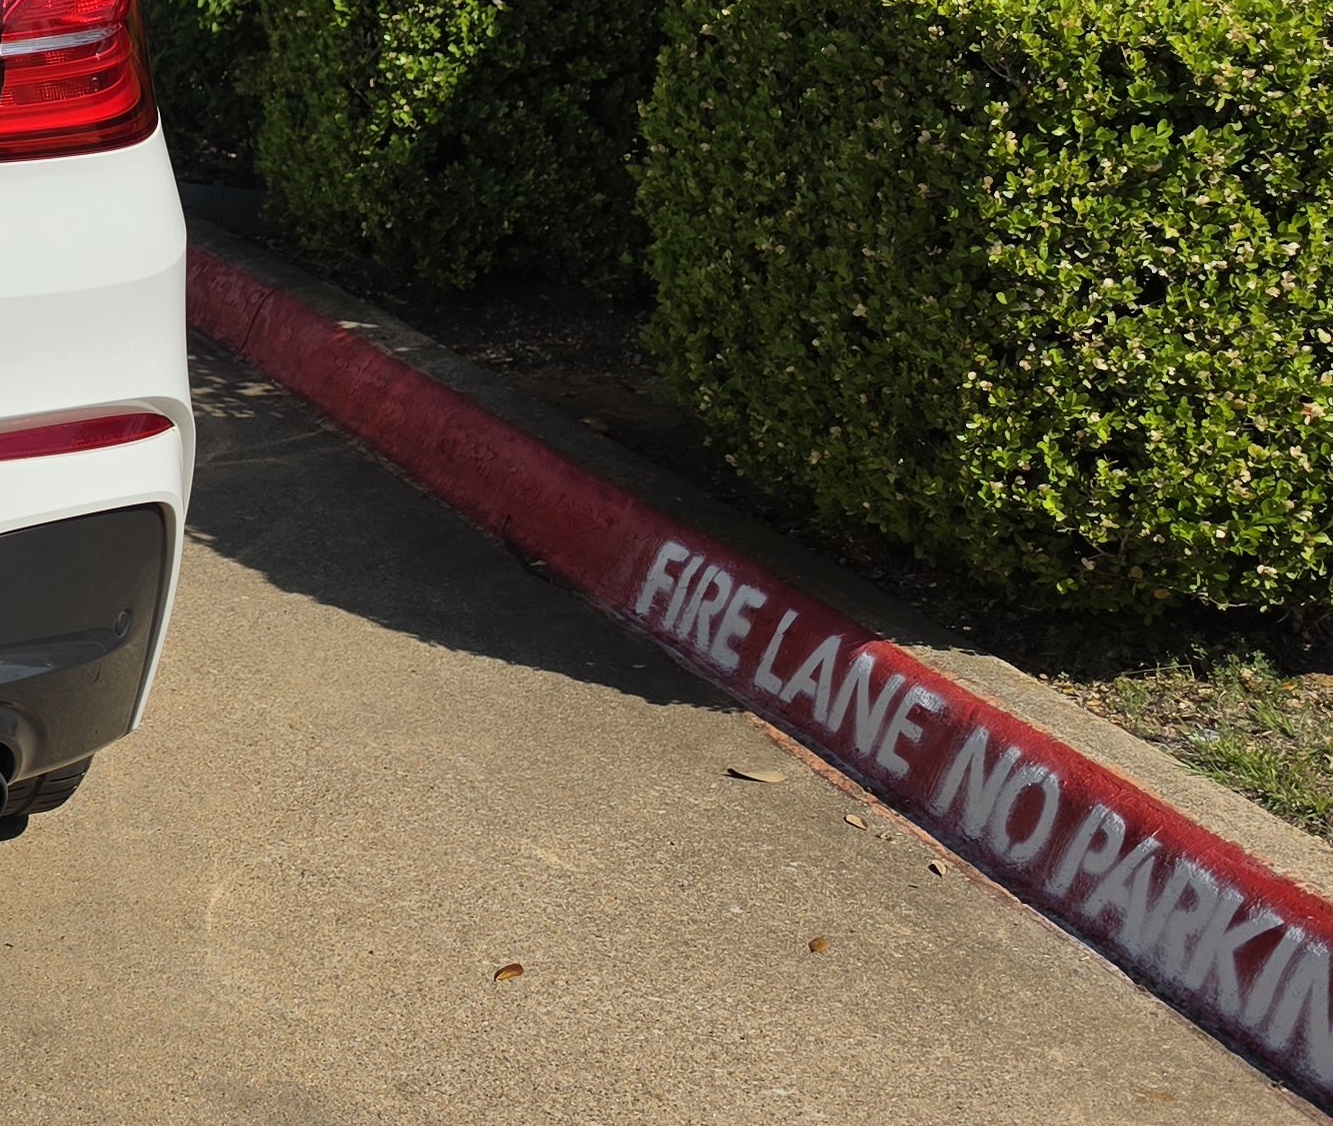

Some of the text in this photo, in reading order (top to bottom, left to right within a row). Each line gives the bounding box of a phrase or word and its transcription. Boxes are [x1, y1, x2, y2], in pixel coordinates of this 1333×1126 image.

[635, 541, 768, 673] FIRE
[753, 609, 942, 778] LANE
[934, 725, 1063, 868] NO
